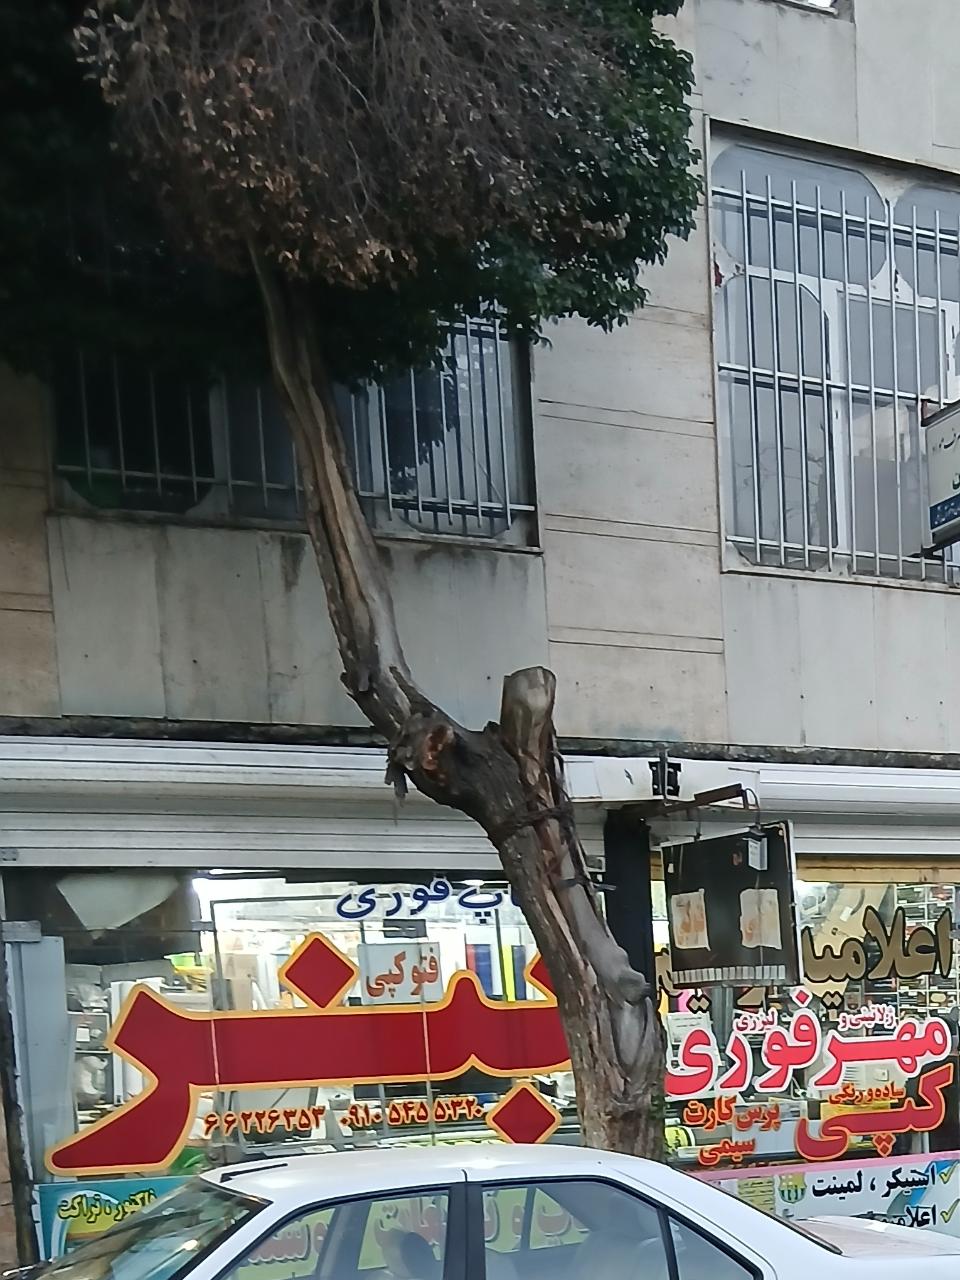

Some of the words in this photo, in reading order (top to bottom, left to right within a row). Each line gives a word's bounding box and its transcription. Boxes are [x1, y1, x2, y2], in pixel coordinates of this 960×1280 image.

[337, 874, 451, 919] فوری
[663, 989, 818, 1096] فوری
[814, 1018, 949, 1088] مهر
[683, 1096, 737, 1132] کارت
[794, 1063, 954, 1161] کپی
[812, 1169, 863, 1200] لمینت
[882, 1165, 936, 1198] استیکر
